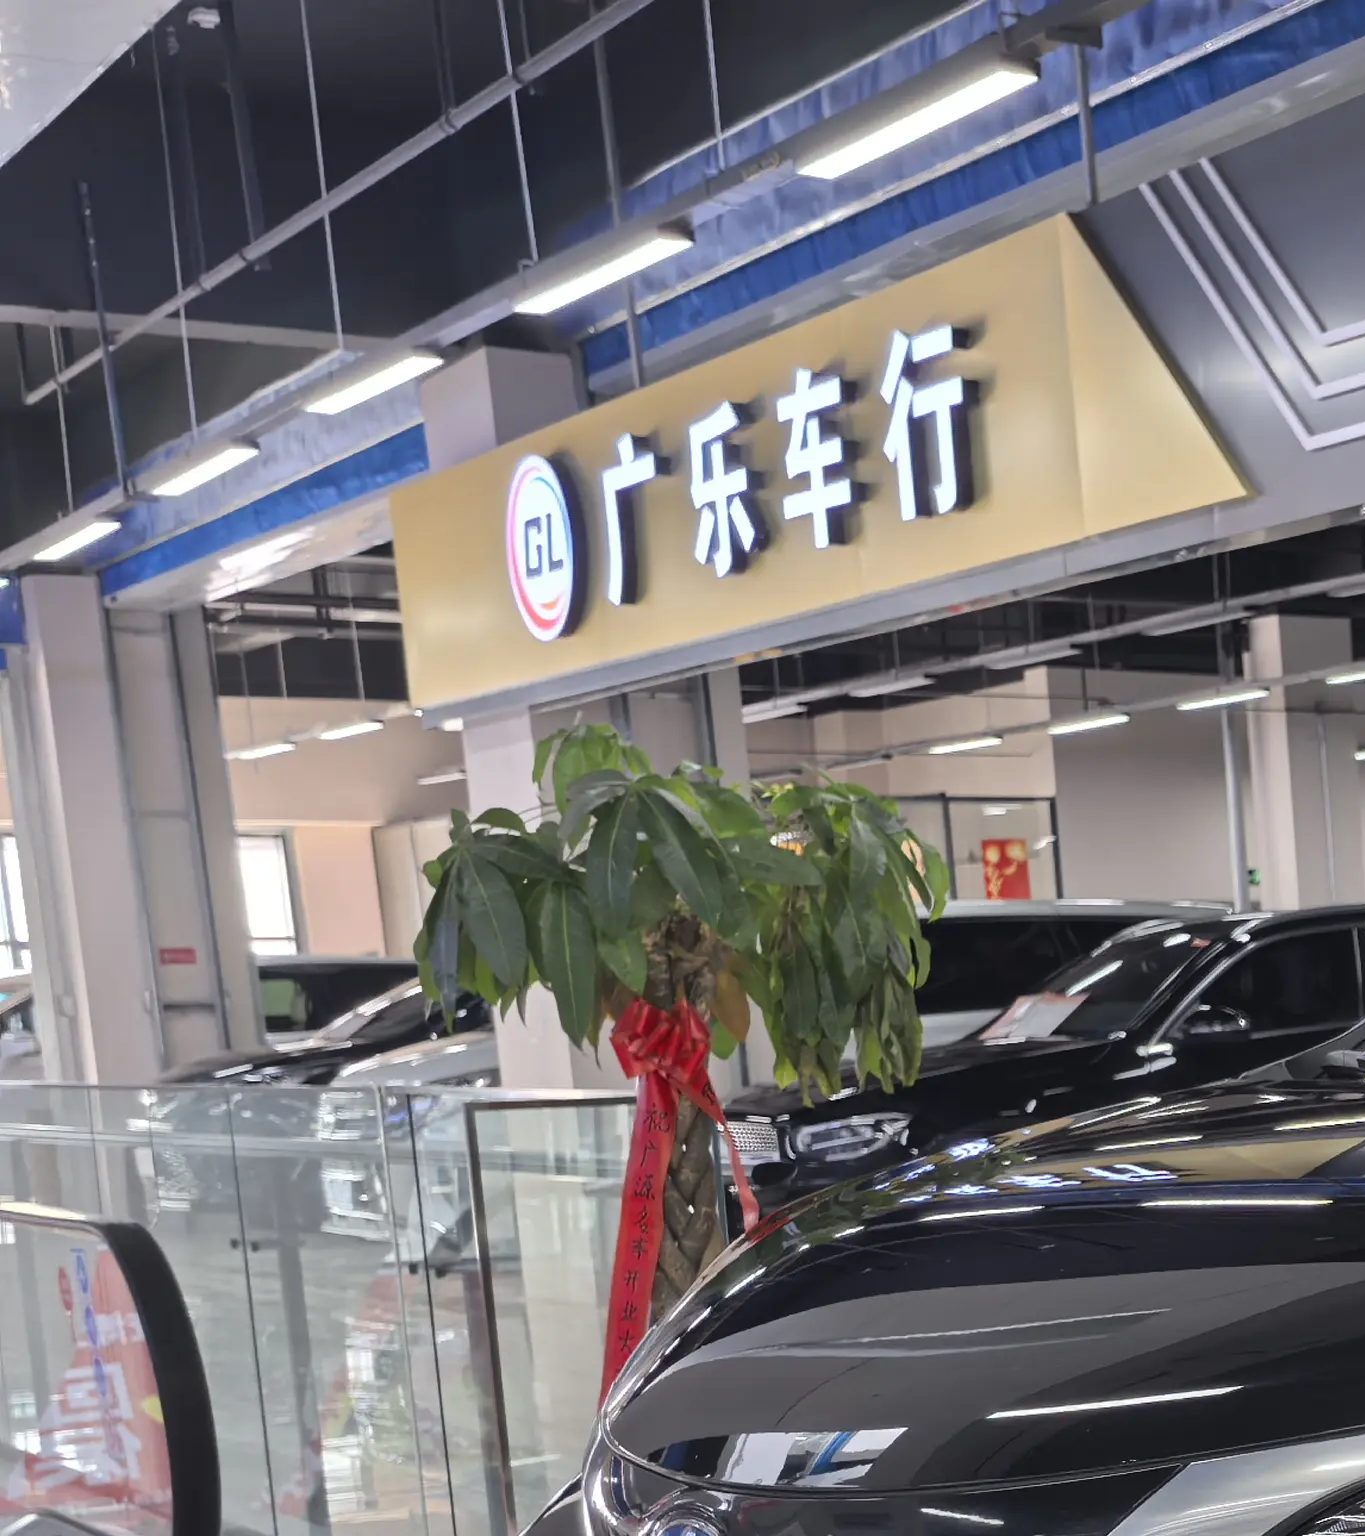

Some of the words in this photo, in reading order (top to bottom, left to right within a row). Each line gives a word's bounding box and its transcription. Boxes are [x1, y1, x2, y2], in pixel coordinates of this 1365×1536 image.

[525, 514, 564, 579] GL
[602, 324, 966, 606] 广乐车行
